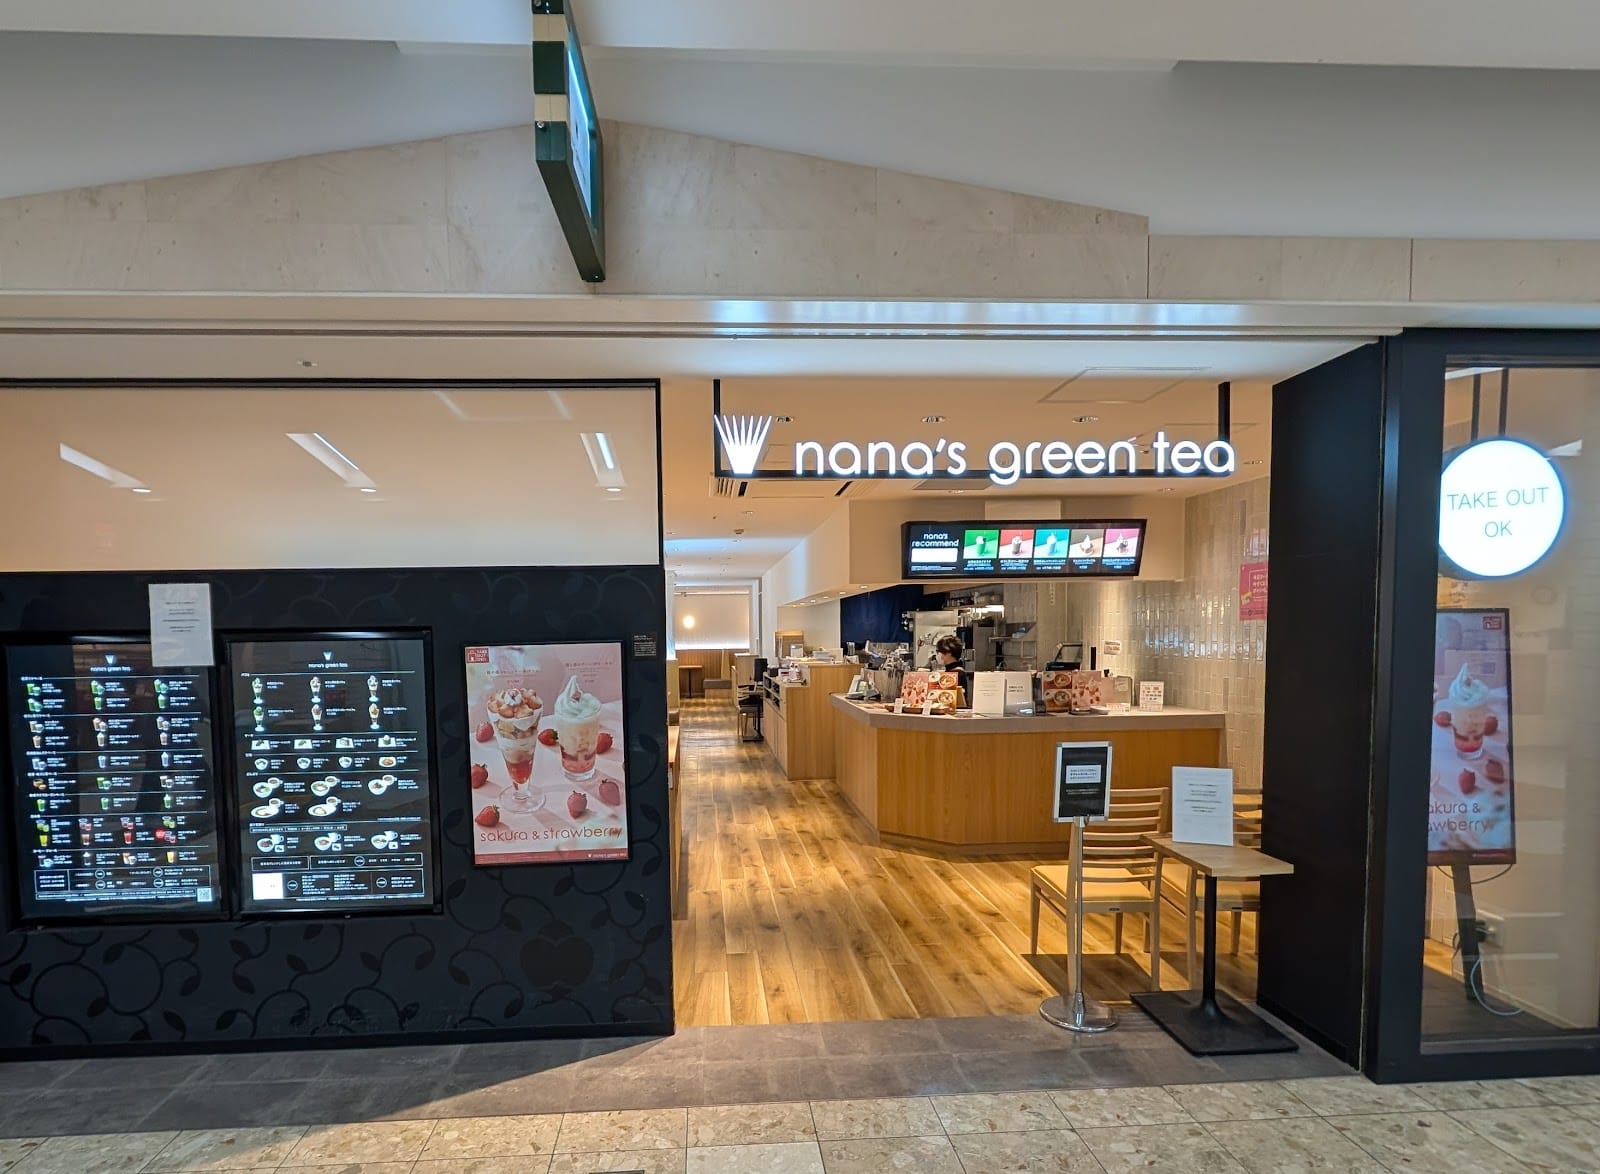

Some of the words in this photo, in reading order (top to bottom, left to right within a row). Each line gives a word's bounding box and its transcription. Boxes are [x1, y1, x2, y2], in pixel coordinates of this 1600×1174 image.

[796, 438, 967, 475] nana's
[988, 441, 1136, 485] green
[1153, 431, 1235, 474] tea
[1447, 491, 1499, 511] TAKE
[1506, 486, 1549, 506] OUT
[1484, 520, 1513, 538] OK
[911, 539, 960, 547] recommend
[1472, 803, 1481, 814] &
[480, 830, 528, 842] sakura
[532, 830, 540, 840] &
[543, 826, 623, 841] strawberry
